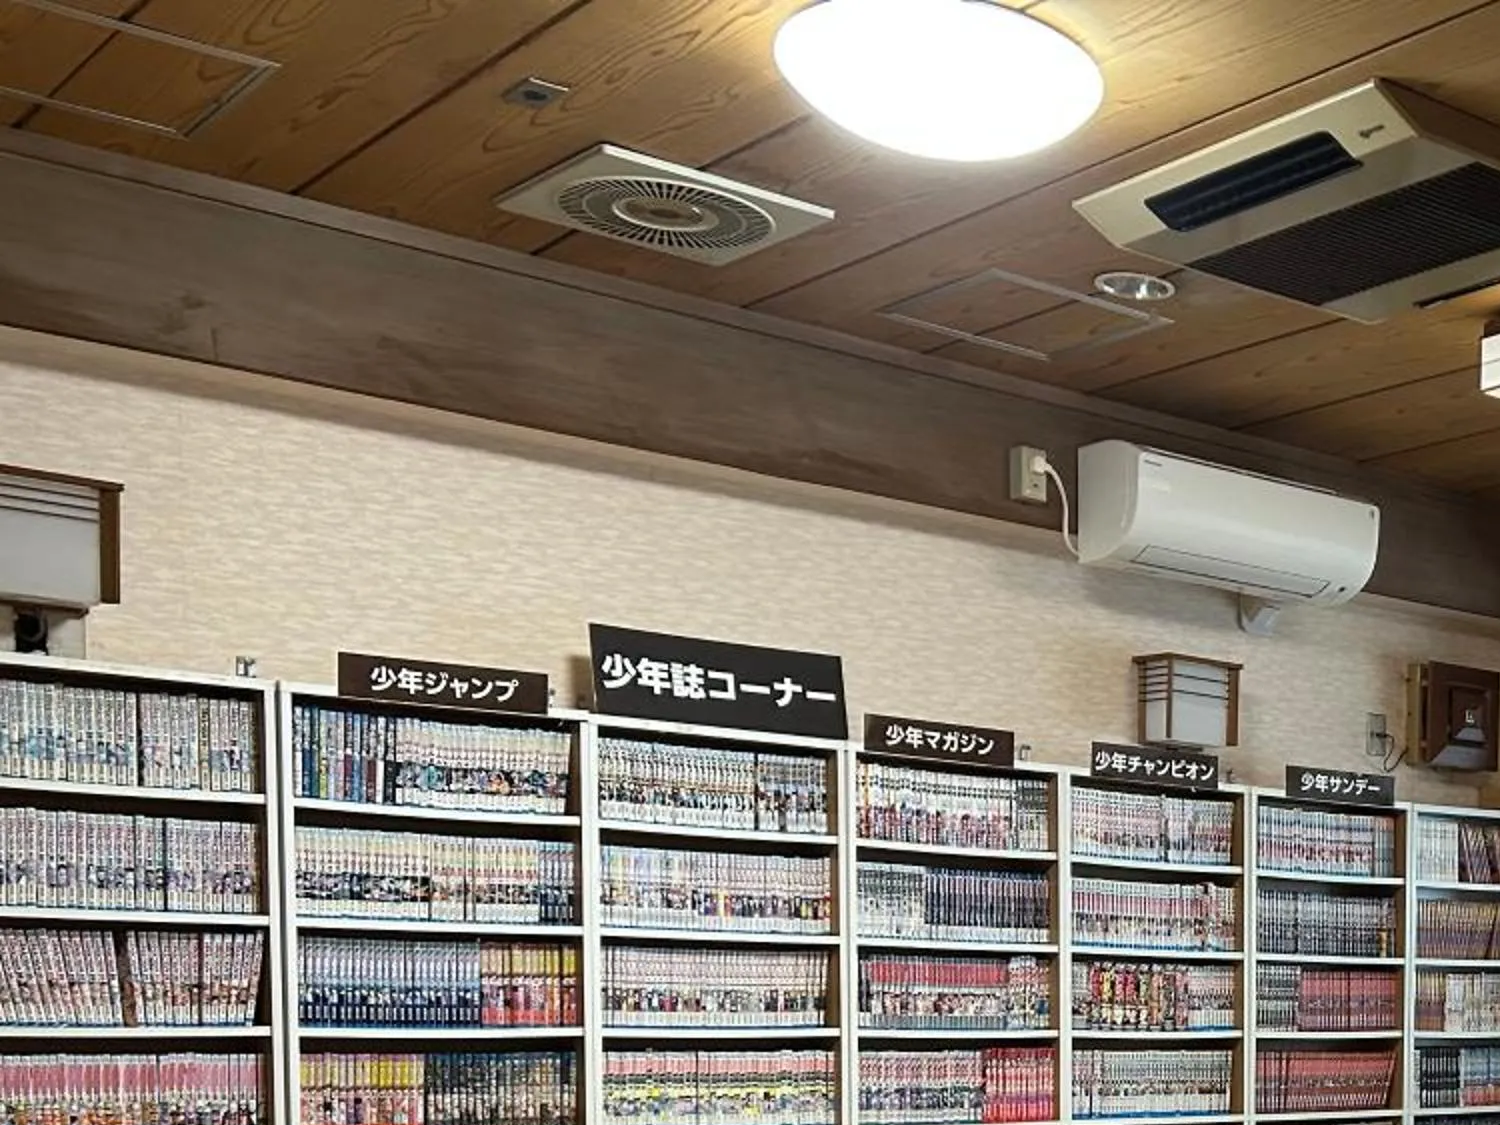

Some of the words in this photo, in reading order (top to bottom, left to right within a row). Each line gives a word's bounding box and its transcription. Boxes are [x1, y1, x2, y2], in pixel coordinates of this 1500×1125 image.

[370, 666, 519, 702] 少年ジャンプ
[601, 653, 836, 707] 少年誌コーナー
[885, 723, 995, 756] 少年マガジン
[1095, 751, 1215, 782] 少年チャンピオン
[1301, 773, 1381, 796] 少年サンデー
